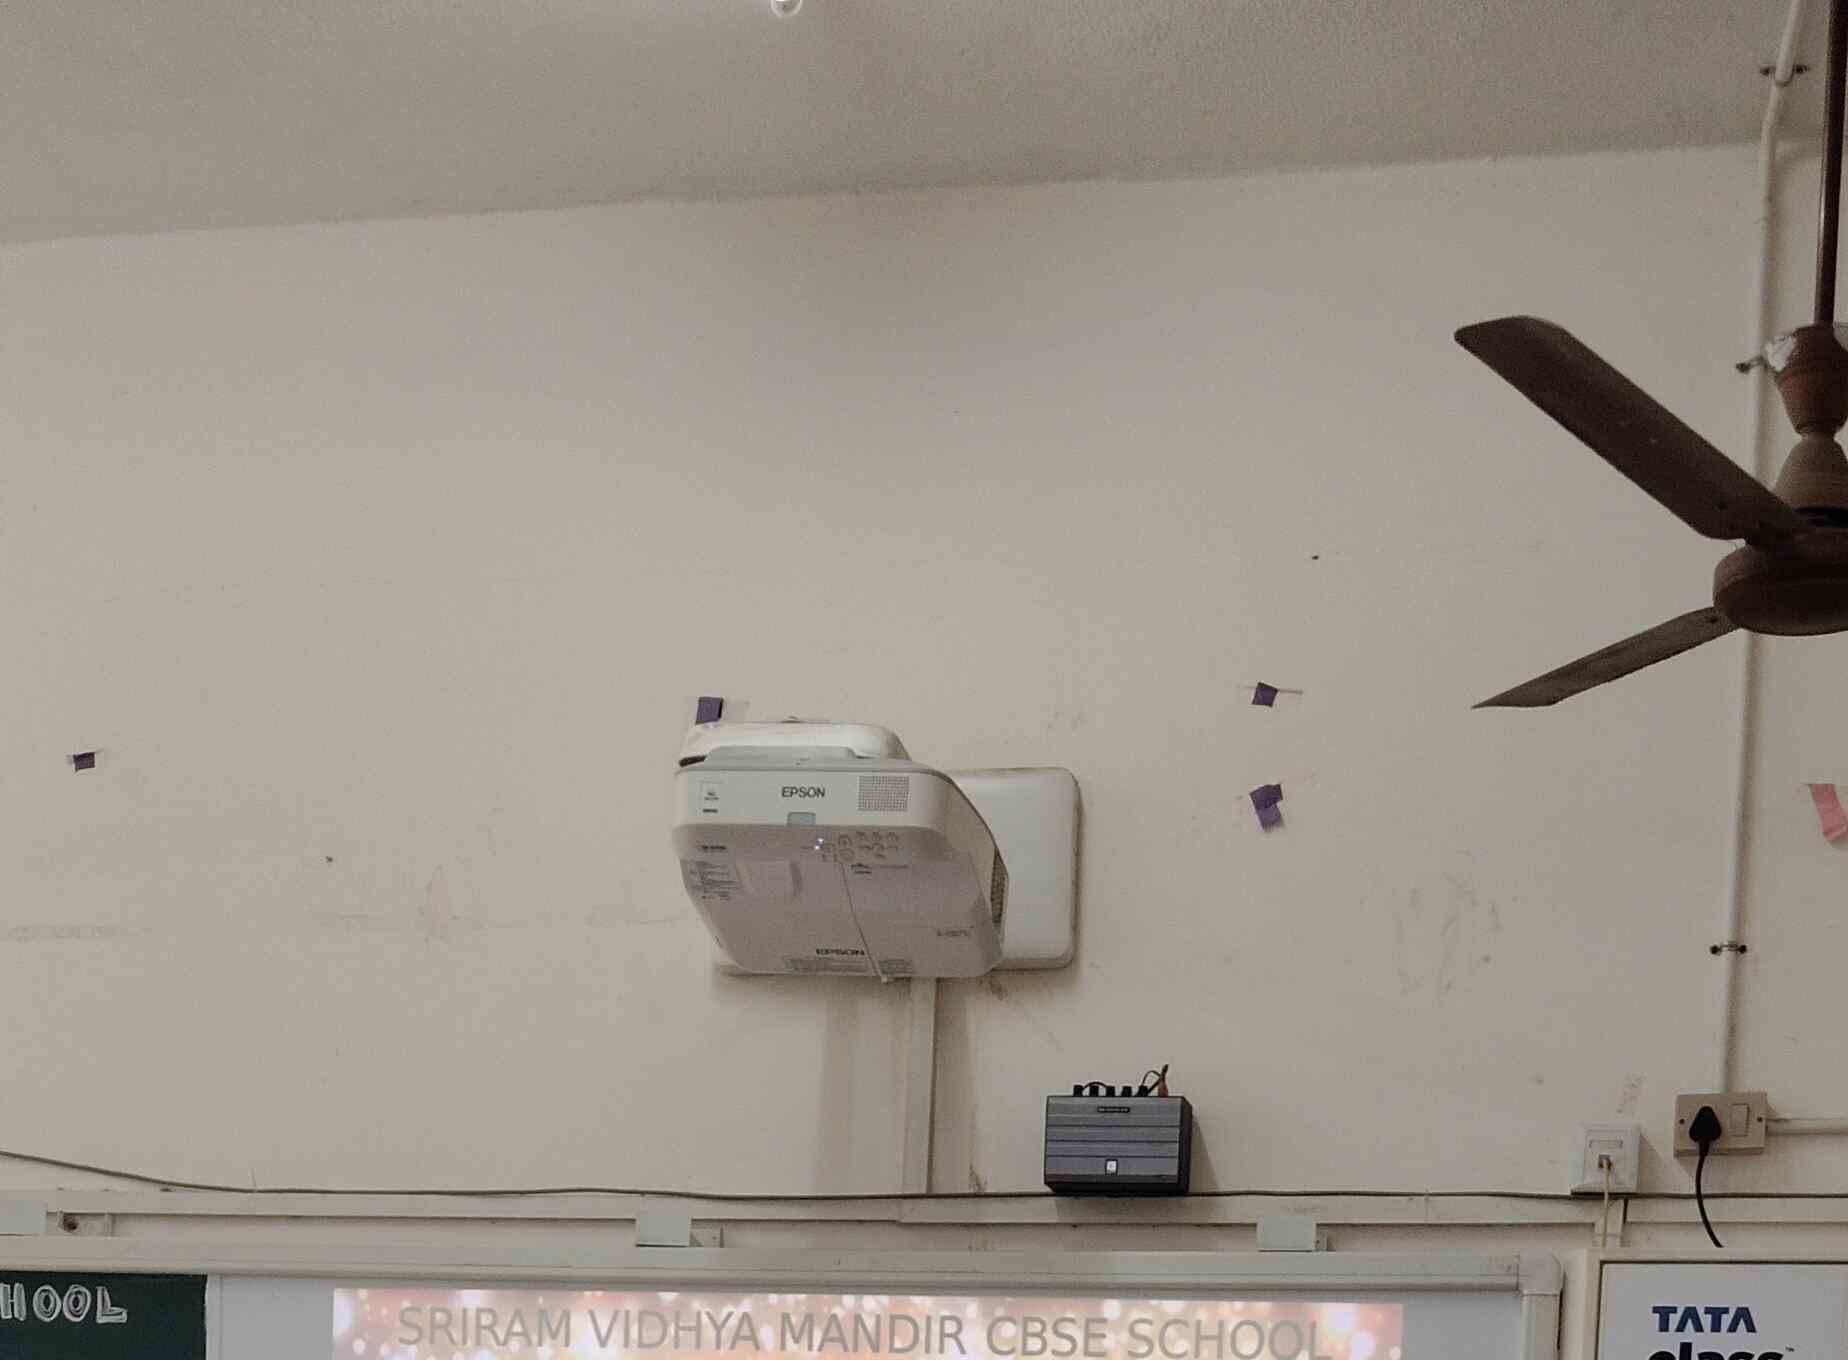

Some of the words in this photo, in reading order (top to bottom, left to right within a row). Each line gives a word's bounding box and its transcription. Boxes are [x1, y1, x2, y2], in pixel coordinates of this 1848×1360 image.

[781, 786, 826, 798] EPSON
[398, 1306, 571, 1348] SRIRAM
[588, 1309, 760, 1352] VIDHYA
[780, 1312, 967, 1356] MANDIR
[986, 1315, 1109, 1359] CBSE
[1652, 1306, 1757, 1333] TATA
